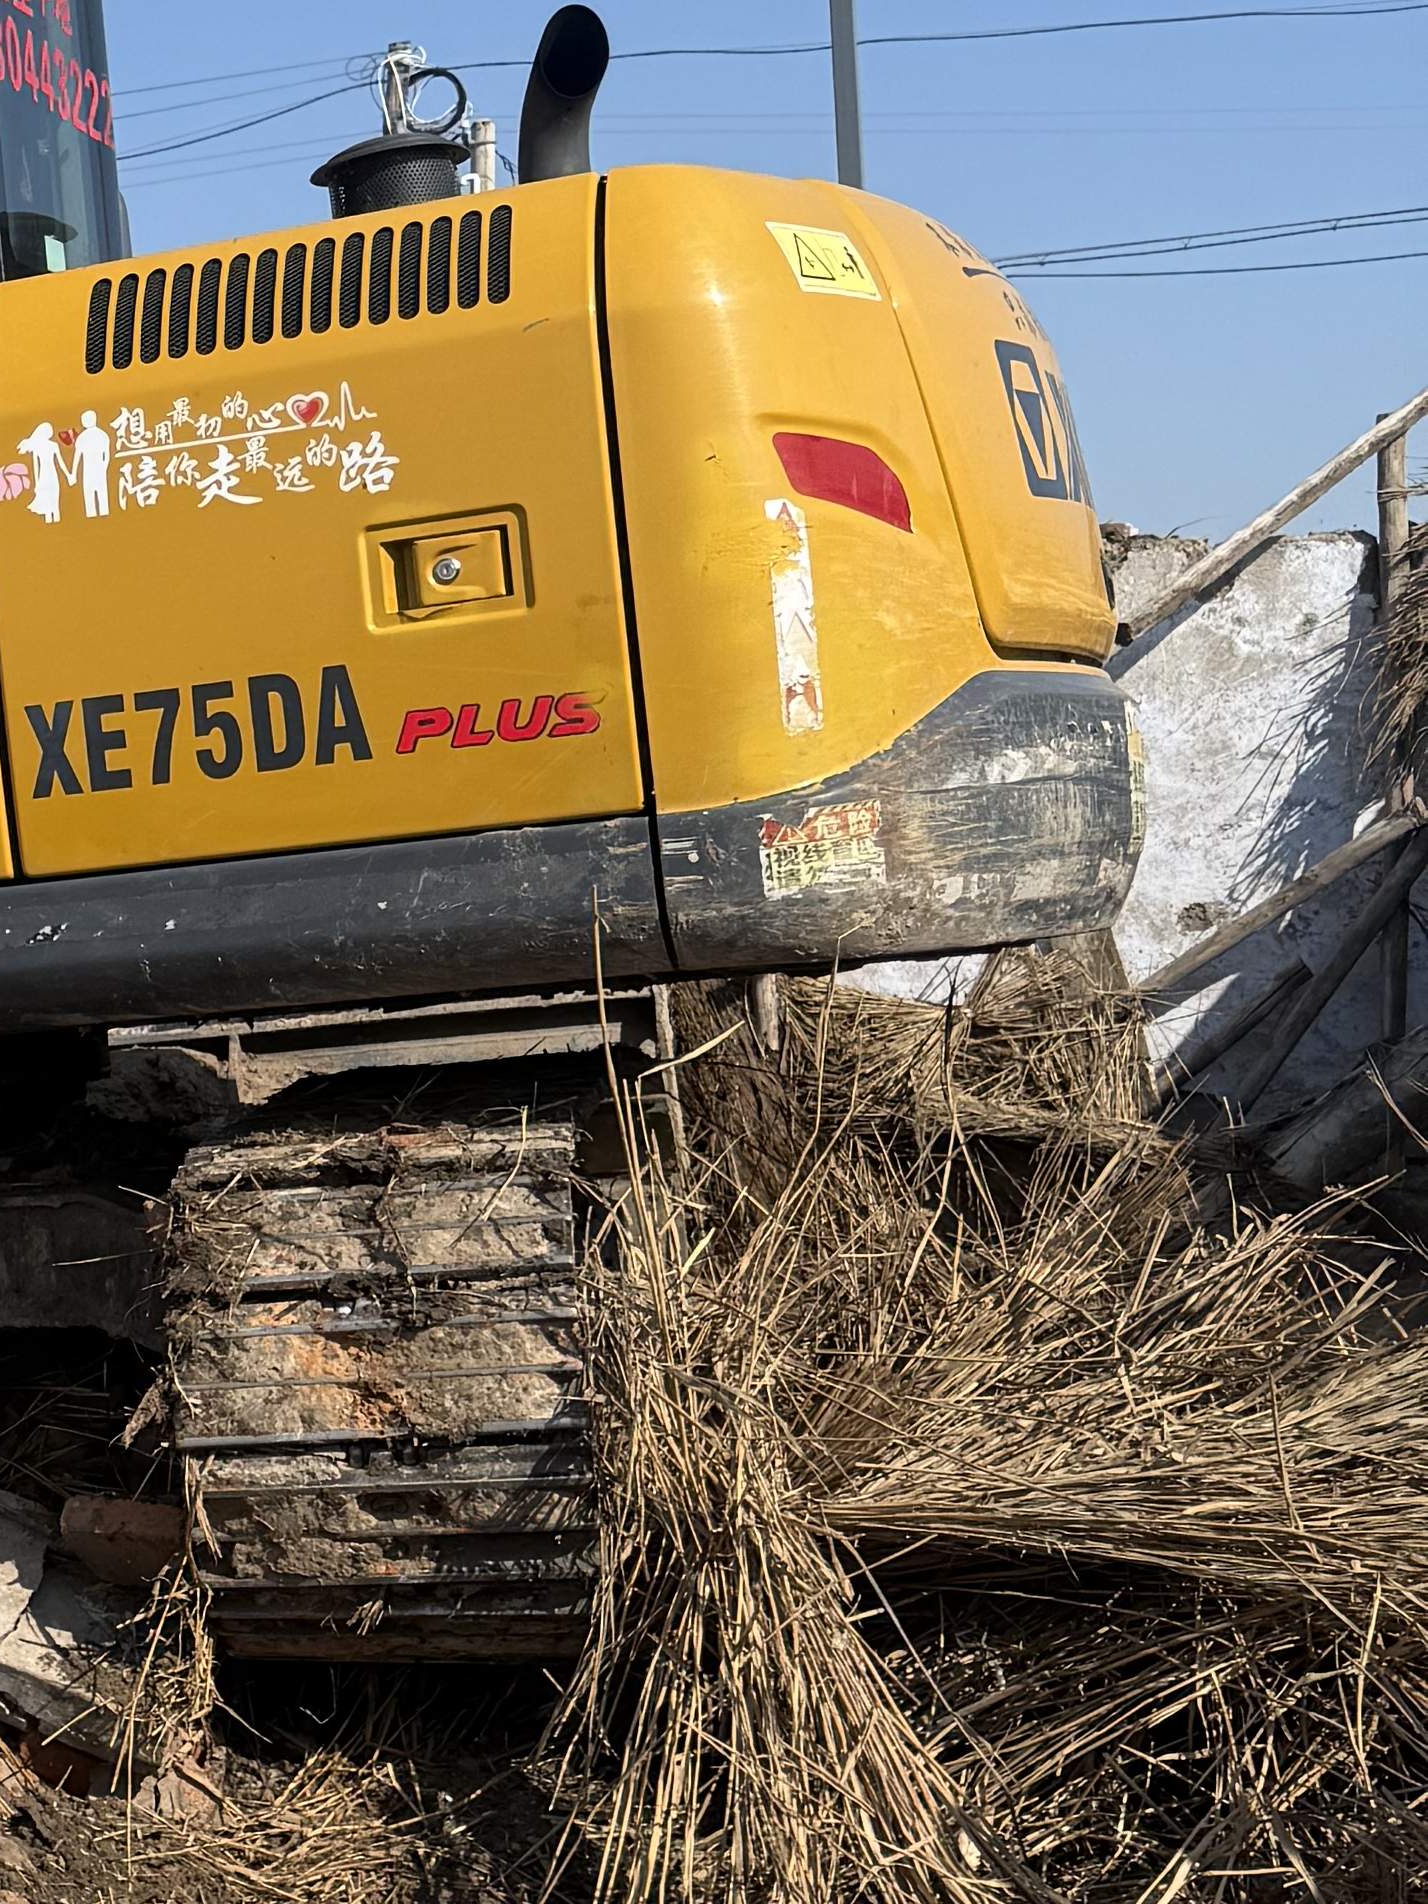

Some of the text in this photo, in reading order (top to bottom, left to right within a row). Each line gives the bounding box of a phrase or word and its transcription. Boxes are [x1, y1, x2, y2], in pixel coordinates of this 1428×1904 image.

[110, 391, 287, 450] 想用最初的心
[117, 431, 400, 510] 陪你走最远的路
[23, 663, 607, 800] XE75DA PLUS
[814, 809, 872, 840] 危险
